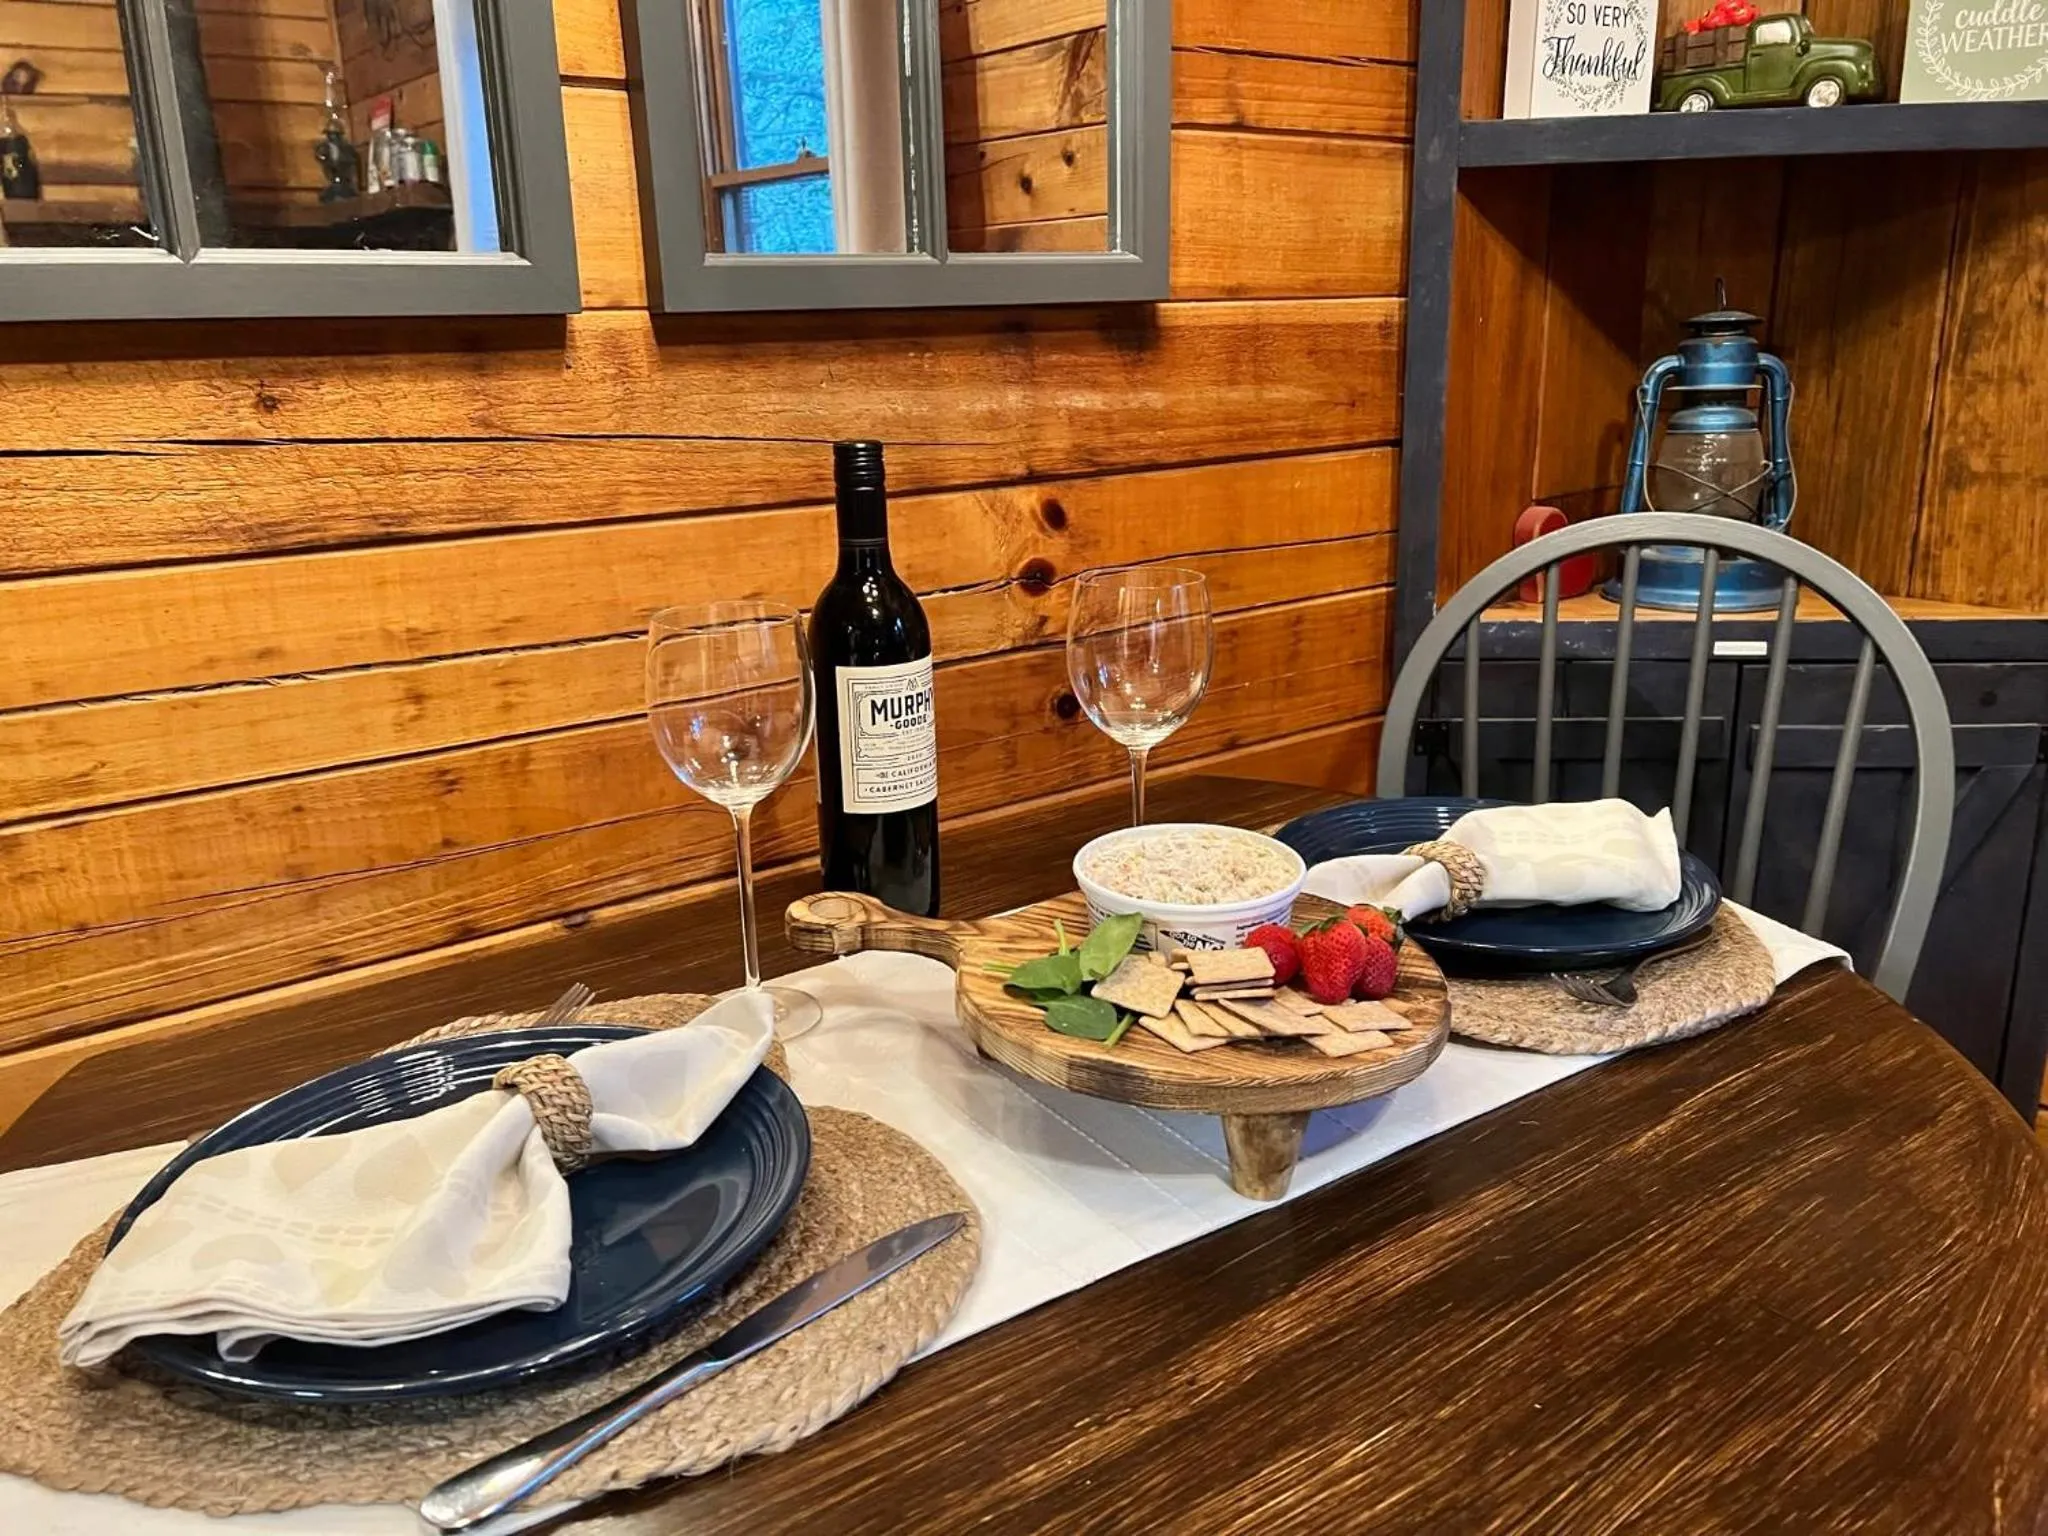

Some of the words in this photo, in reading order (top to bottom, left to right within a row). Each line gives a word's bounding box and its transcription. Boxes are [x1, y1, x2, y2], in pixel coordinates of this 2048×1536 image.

[1566, 2, 1586, 25] SO
[1594, 4, 1632, 28] VERY
[1954, 0, 2046, 30] cuddle
[1542, 34, 1648, 82] Thankful
[870, 687, 933, 726] MURPH
[869, 782, 913, 793] CABERNET
